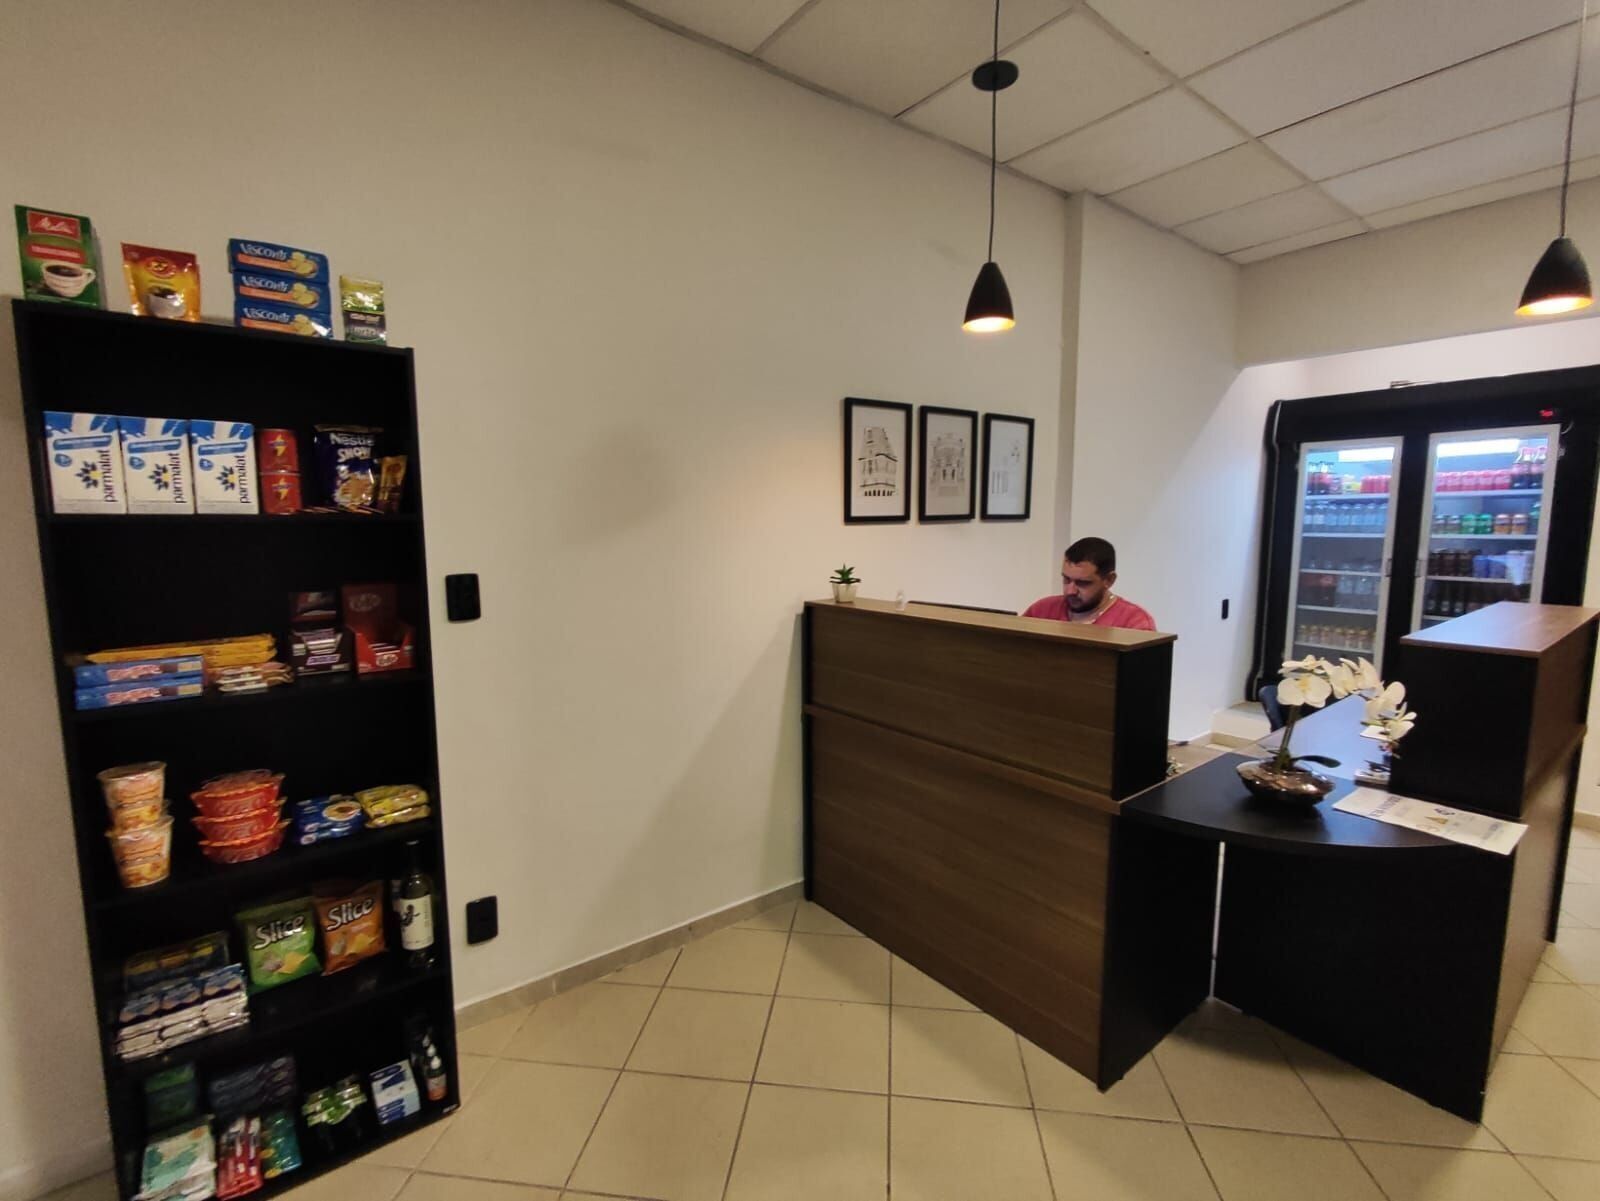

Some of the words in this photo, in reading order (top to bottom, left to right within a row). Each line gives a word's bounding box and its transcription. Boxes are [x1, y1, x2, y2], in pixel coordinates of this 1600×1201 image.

[97, 449, 118, 503] parmalat
[168, 452, 188, 504] parmalat
[234, 454, 252, 504] parmalat
[253, 915, 305, 950] Slice
[326, 898, 375, 931] Slice
